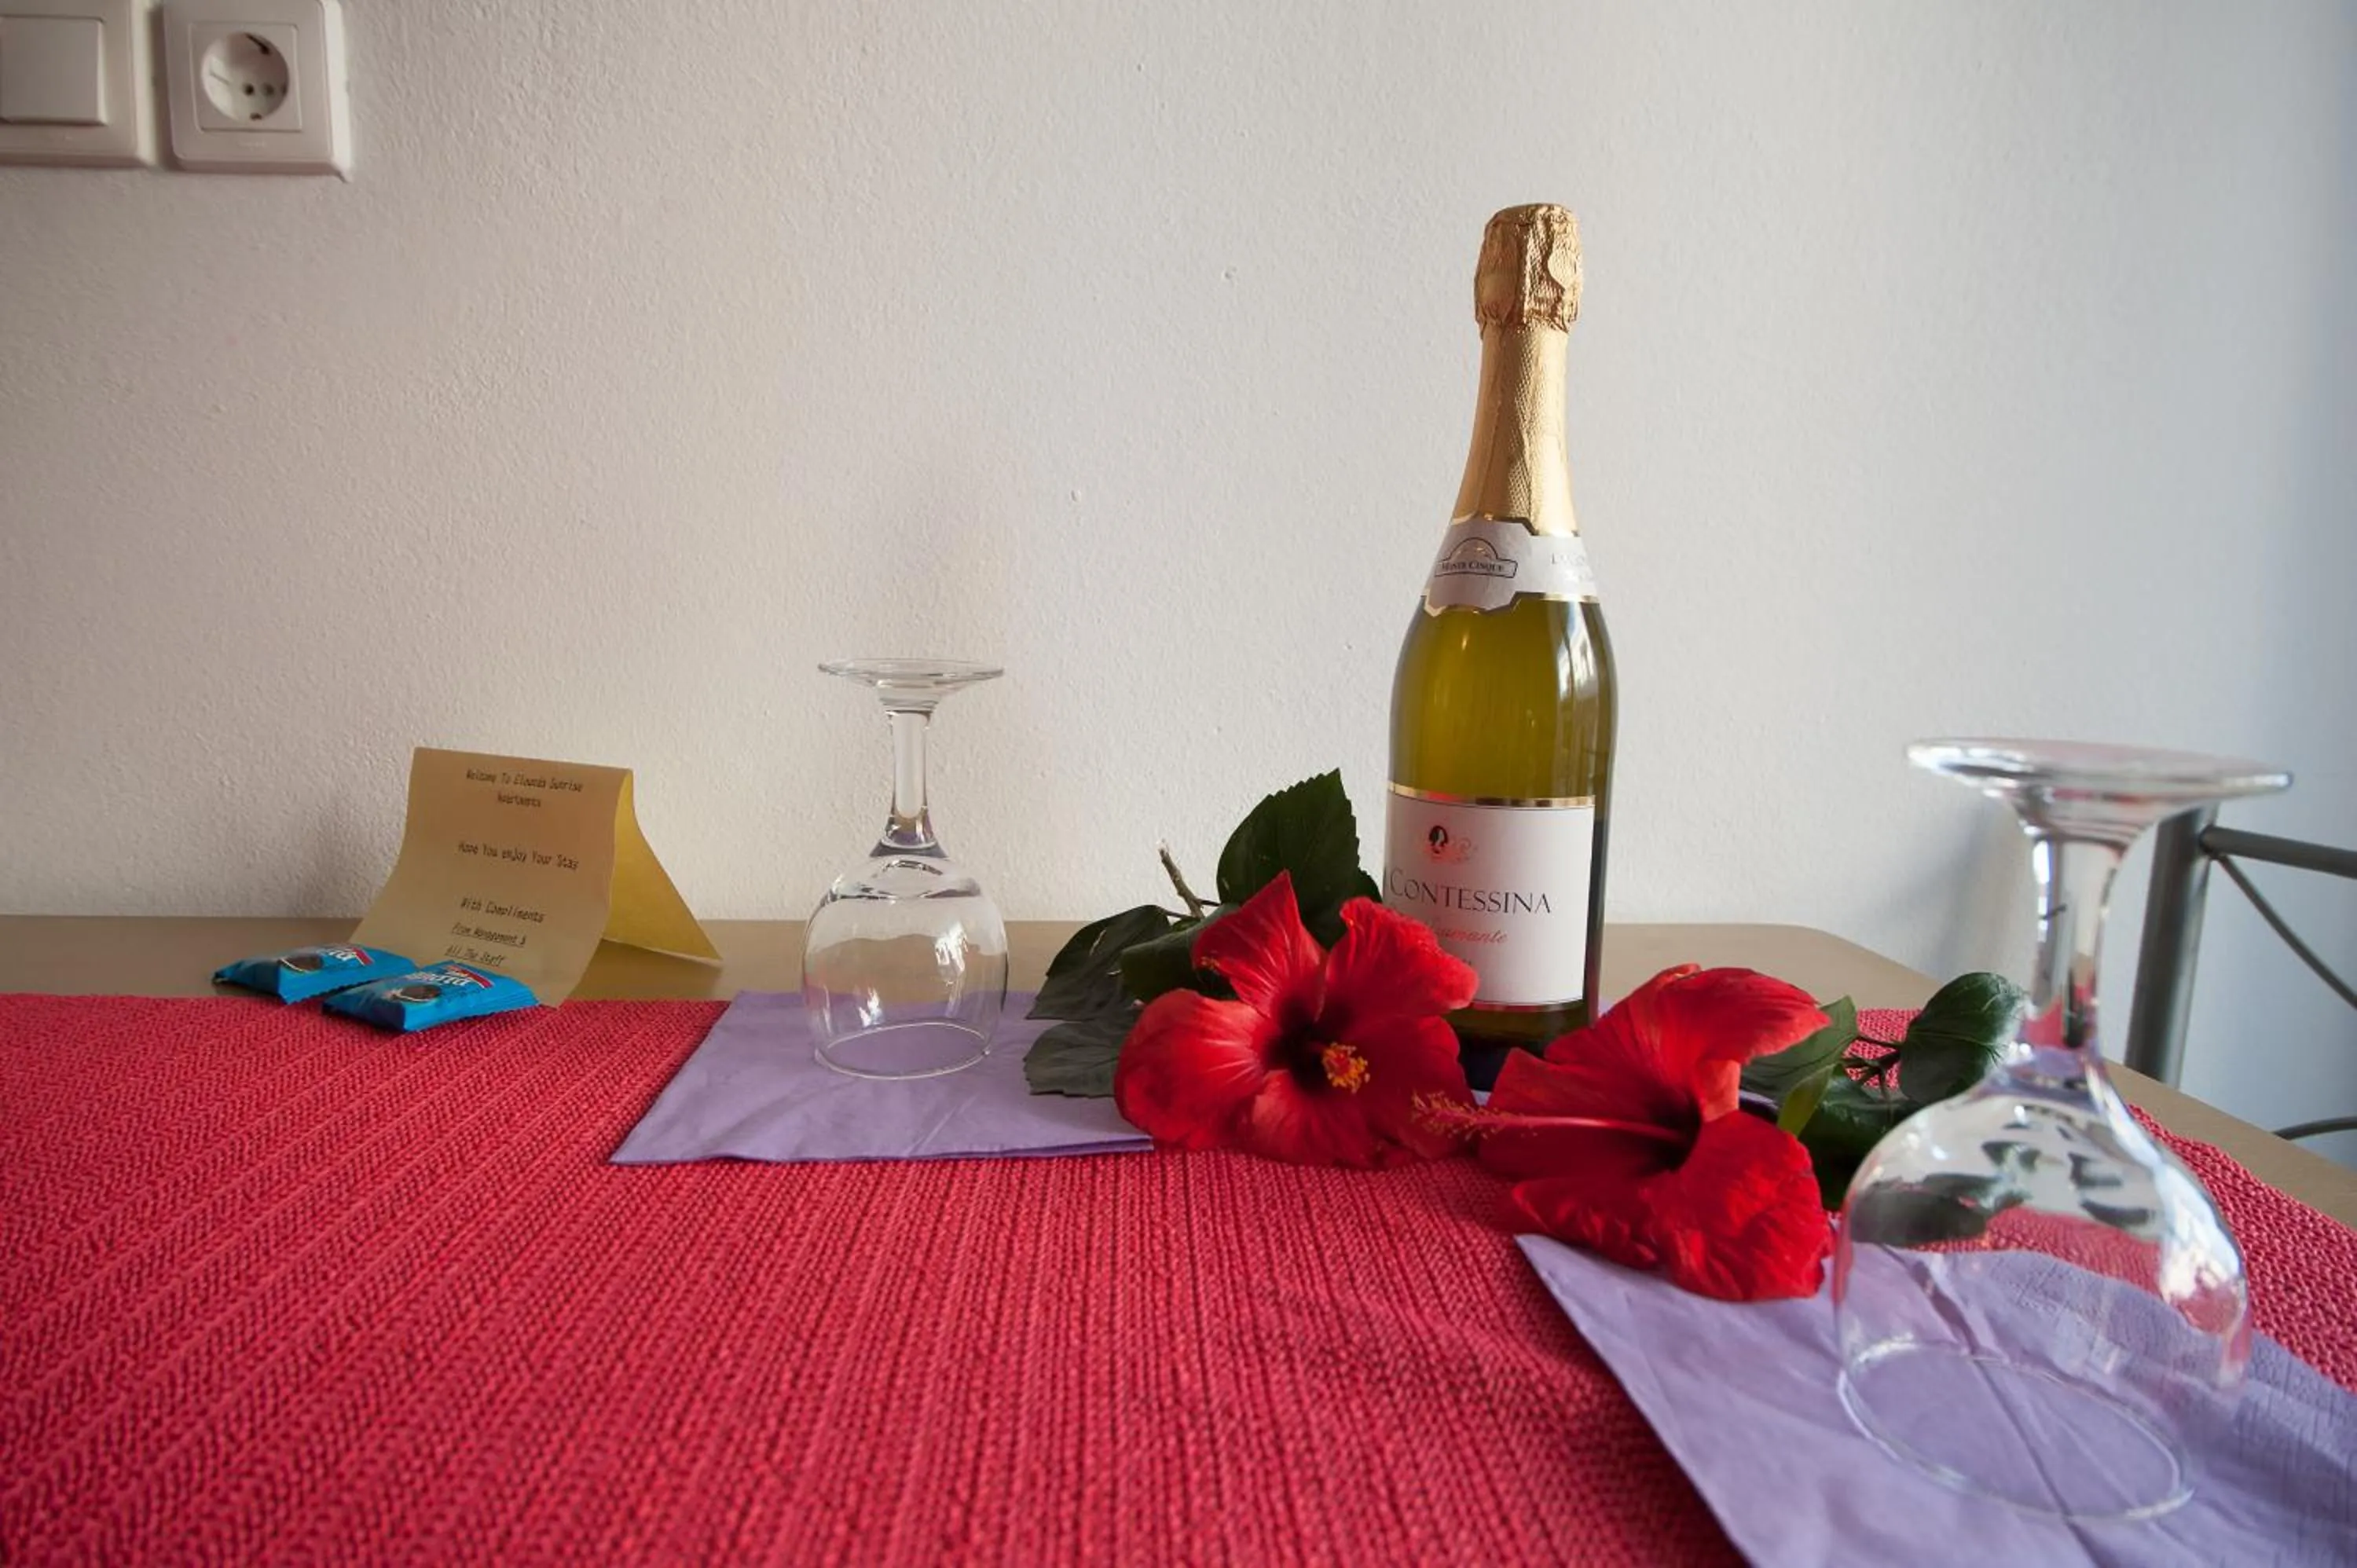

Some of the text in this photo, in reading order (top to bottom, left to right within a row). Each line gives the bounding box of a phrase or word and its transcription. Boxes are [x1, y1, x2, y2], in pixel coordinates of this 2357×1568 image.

[1390, 867, 1552, 914] CONTESSINA
[461, 898, 544, 923] With Compliments
